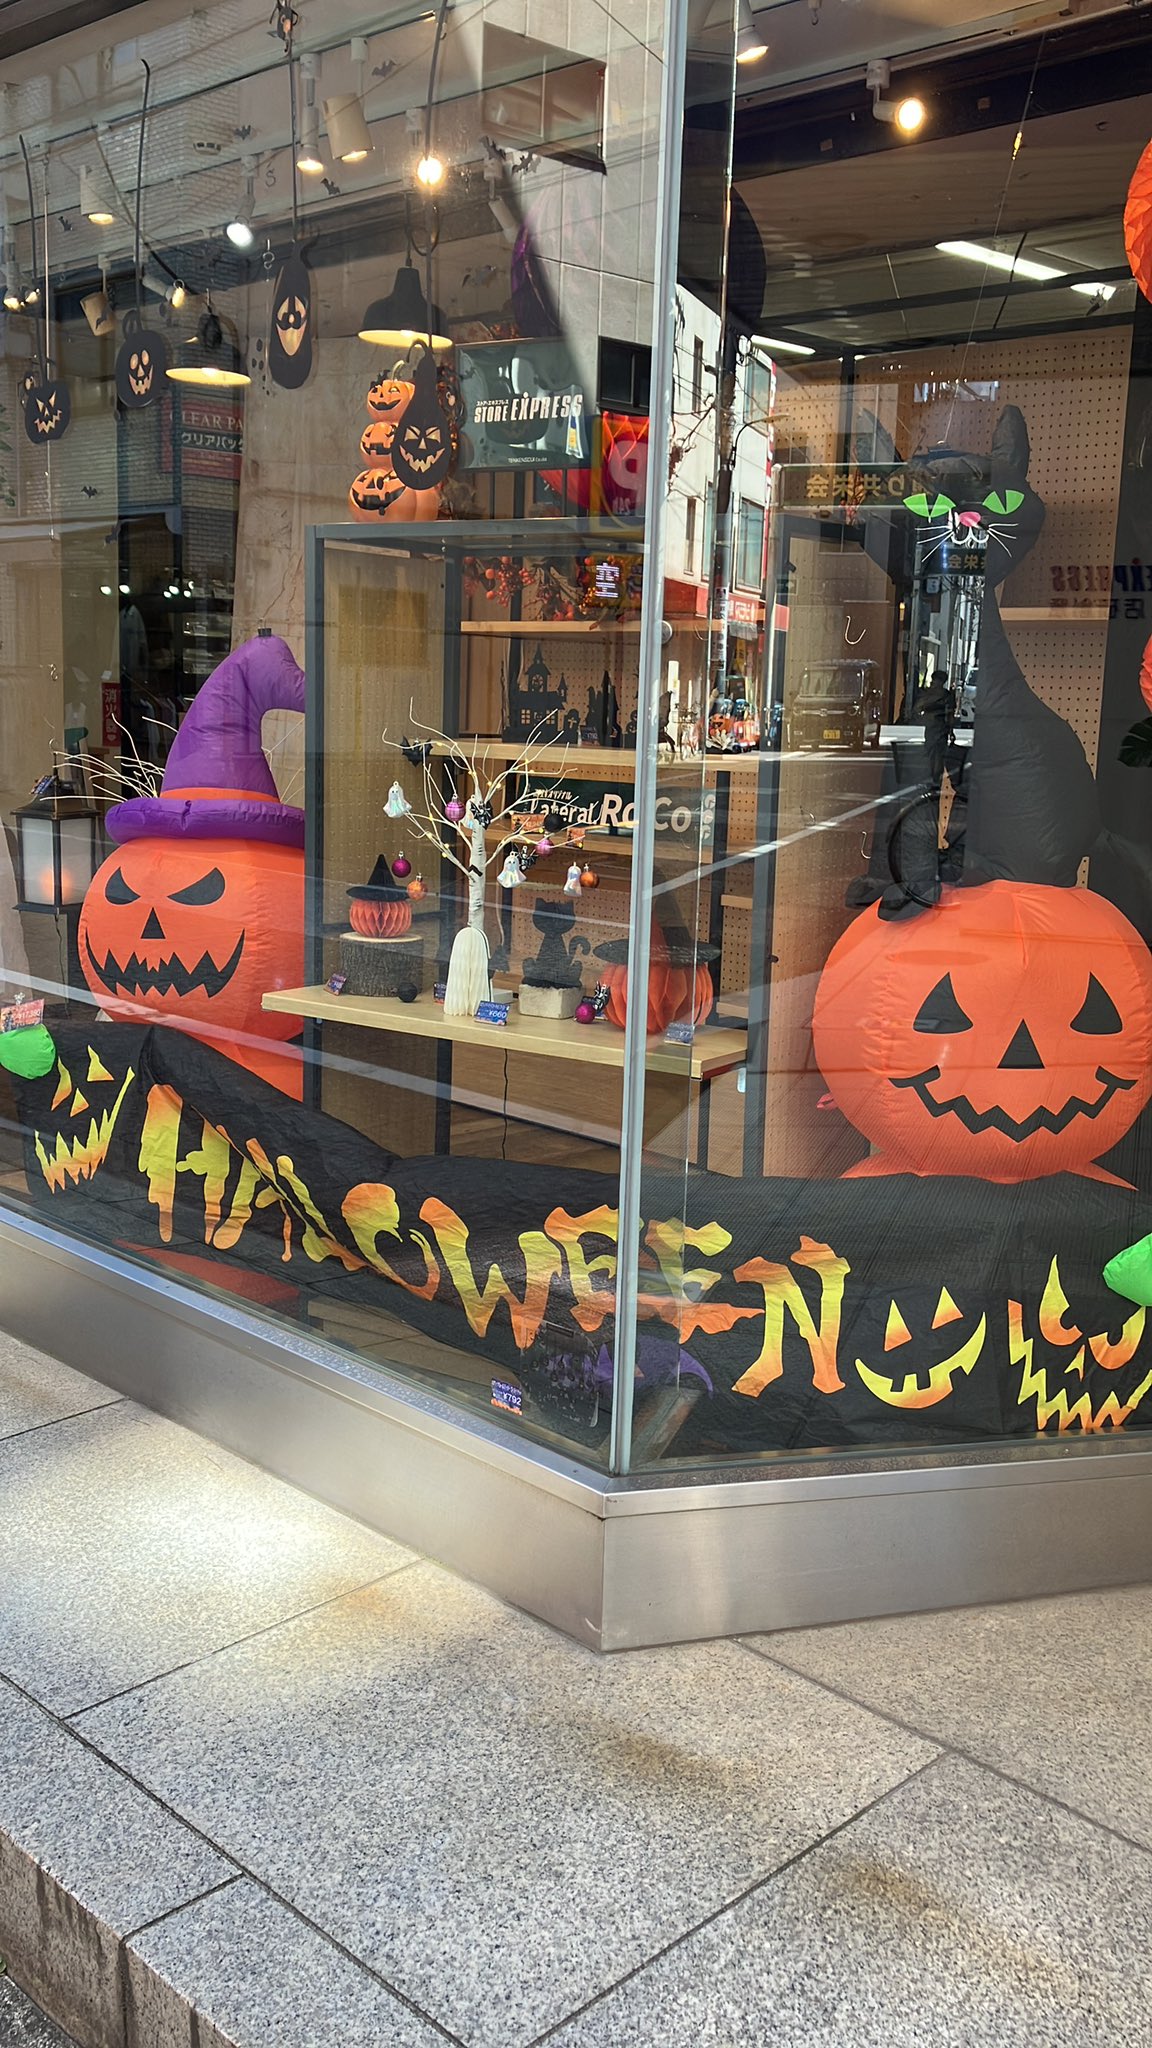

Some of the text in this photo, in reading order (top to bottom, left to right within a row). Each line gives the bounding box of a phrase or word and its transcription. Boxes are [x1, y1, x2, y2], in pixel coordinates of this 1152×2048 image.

[474, 392, 583, 423] STORE EXPRESS
[489, 1010, 507, 1019] ¥660
[504, 1392, 522, 1406] ¥792
